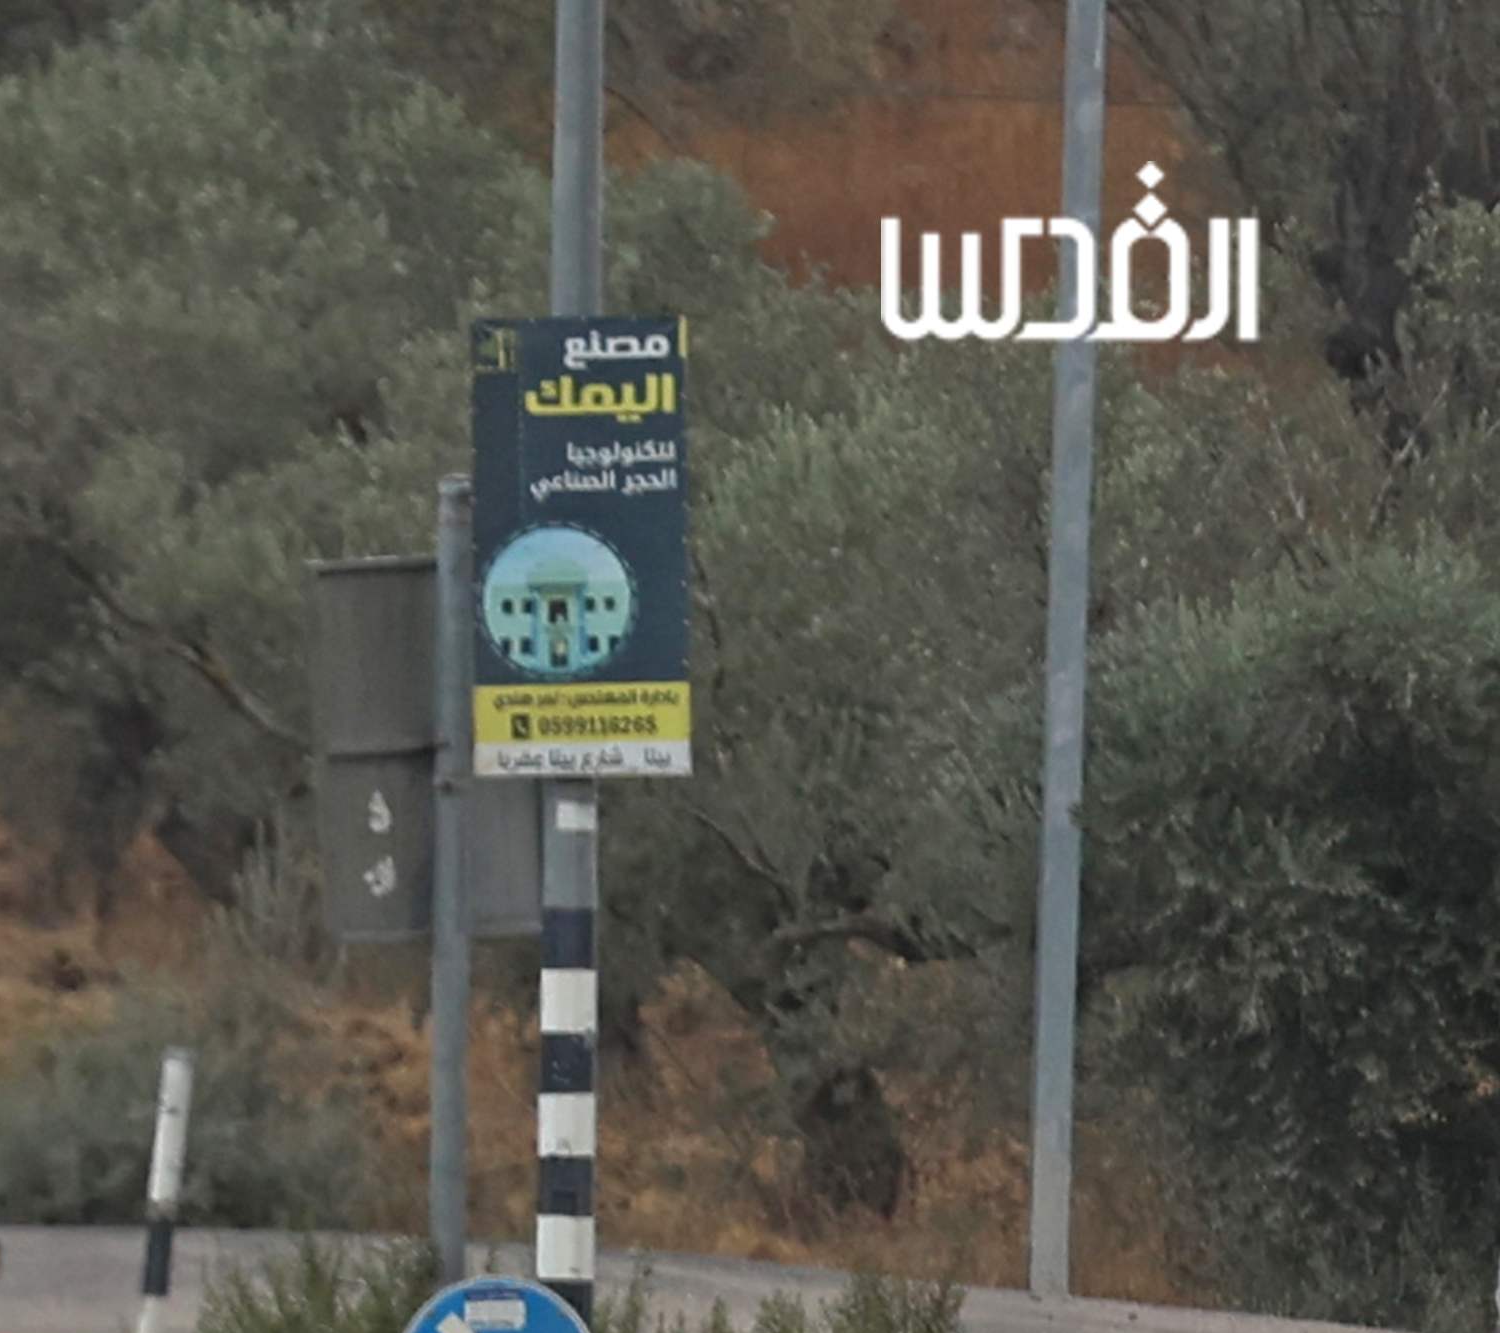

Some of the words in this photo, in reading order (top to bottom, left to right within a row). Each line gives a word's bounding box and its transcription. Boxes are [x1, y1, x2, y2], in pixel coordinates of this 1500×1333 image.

[564, 330, 669, 370] مصنع
[529, 468, 616, 502] الصناعي
[621, 468, 678, 496] الحجر
